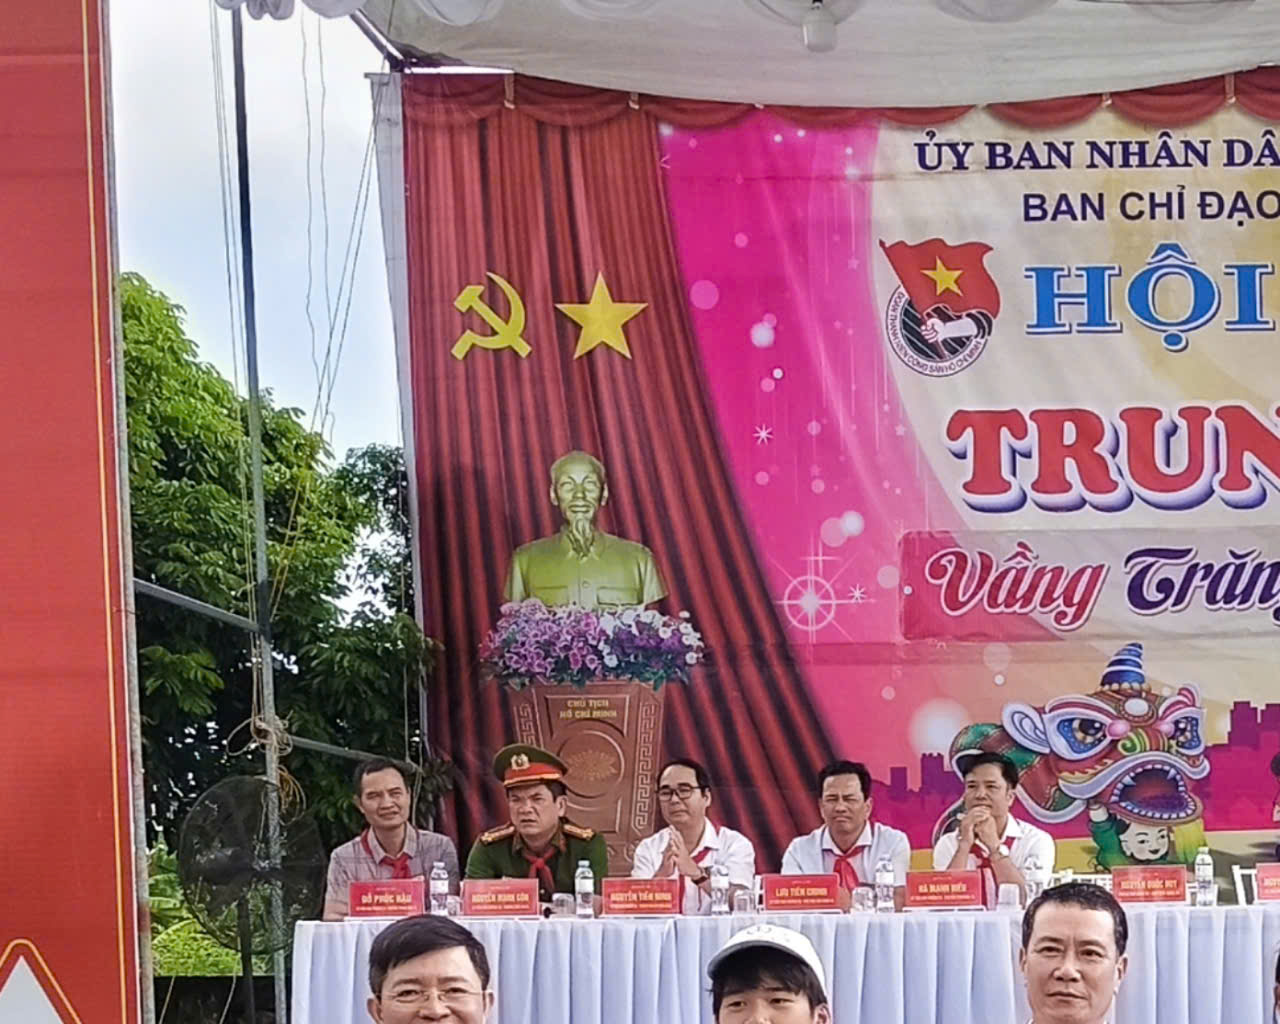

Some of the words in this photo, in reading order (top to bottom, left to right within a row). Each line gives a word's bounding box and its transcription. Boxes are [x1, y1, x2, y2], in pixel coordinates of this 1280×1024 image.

[914, 130, 971, 171] ỦY
[984, 140, 1075, 171] BAN
[1086, 130, 1210, 170] NHÂN
[1023, 192, 1104, 222] BAN
[1119, 185, 1184, 221] CHỈ
[1024, 242, 1275, 352] HỘI
[925, 541, 1107, 632] Vầng
[593, 709, 617, 718] MINH
